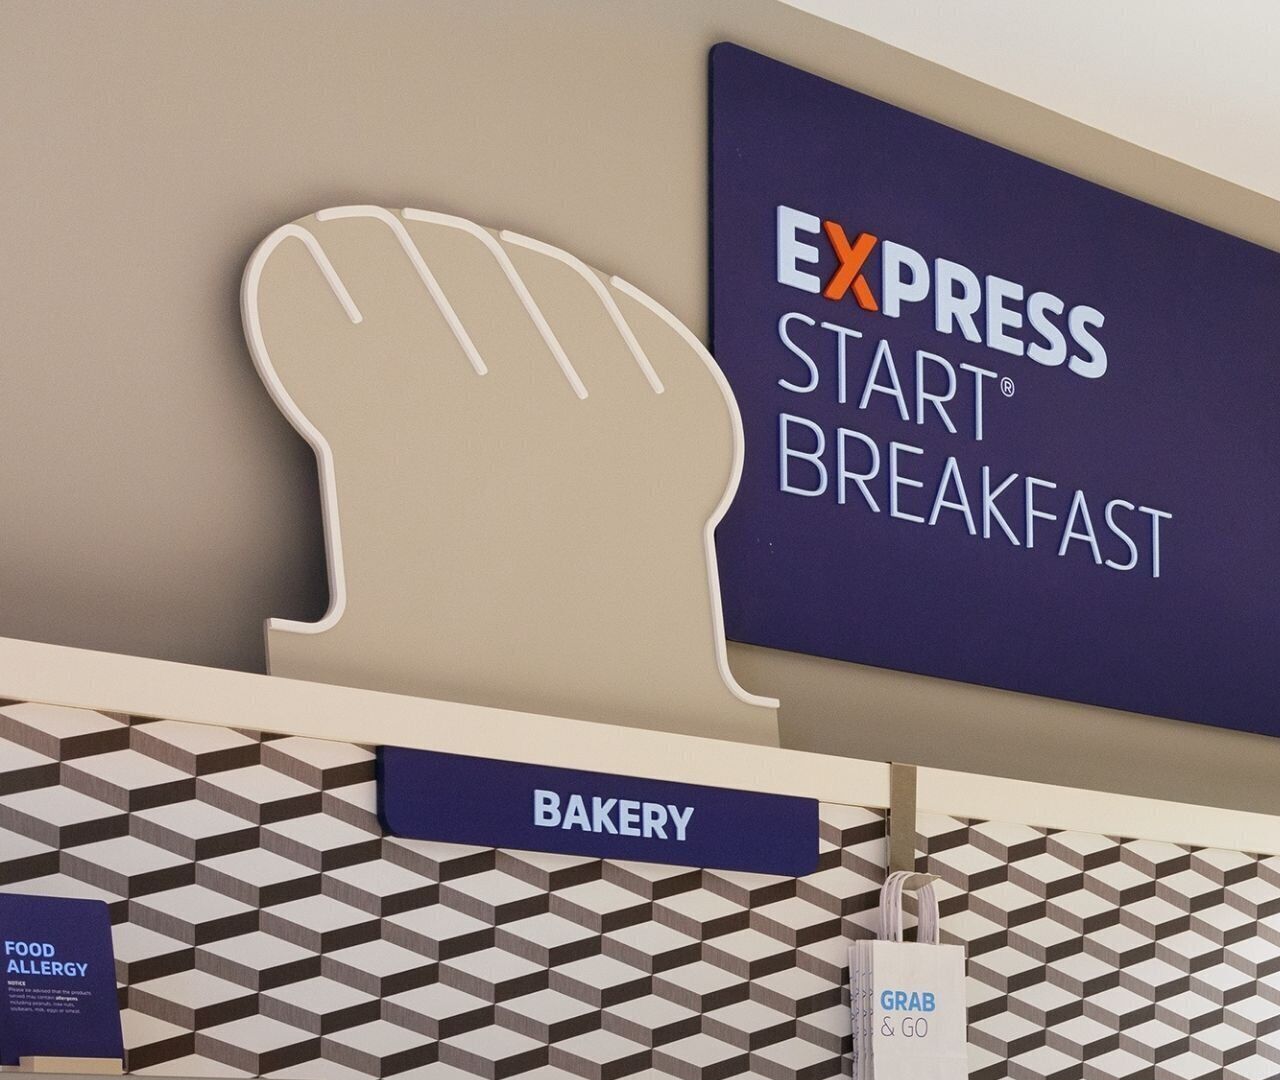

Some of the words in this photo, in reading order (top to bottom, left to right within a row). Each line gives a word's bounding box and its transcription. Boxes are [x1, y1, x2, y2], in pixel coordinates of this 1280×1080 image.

[777, 205, 1108, 379] EXPRESS
[779, 412, 1173, 579] BREAKFAST
[534, 789, 695, 841] BAKERY
[4, 940, 56, 958] FOOD
[7, 959, 88, 977] ALLERGY
[880, 989, 936, 1012] GRAB
[880, 1016, 895, 1037] &
[901, 1017, 928, 1038] GO
